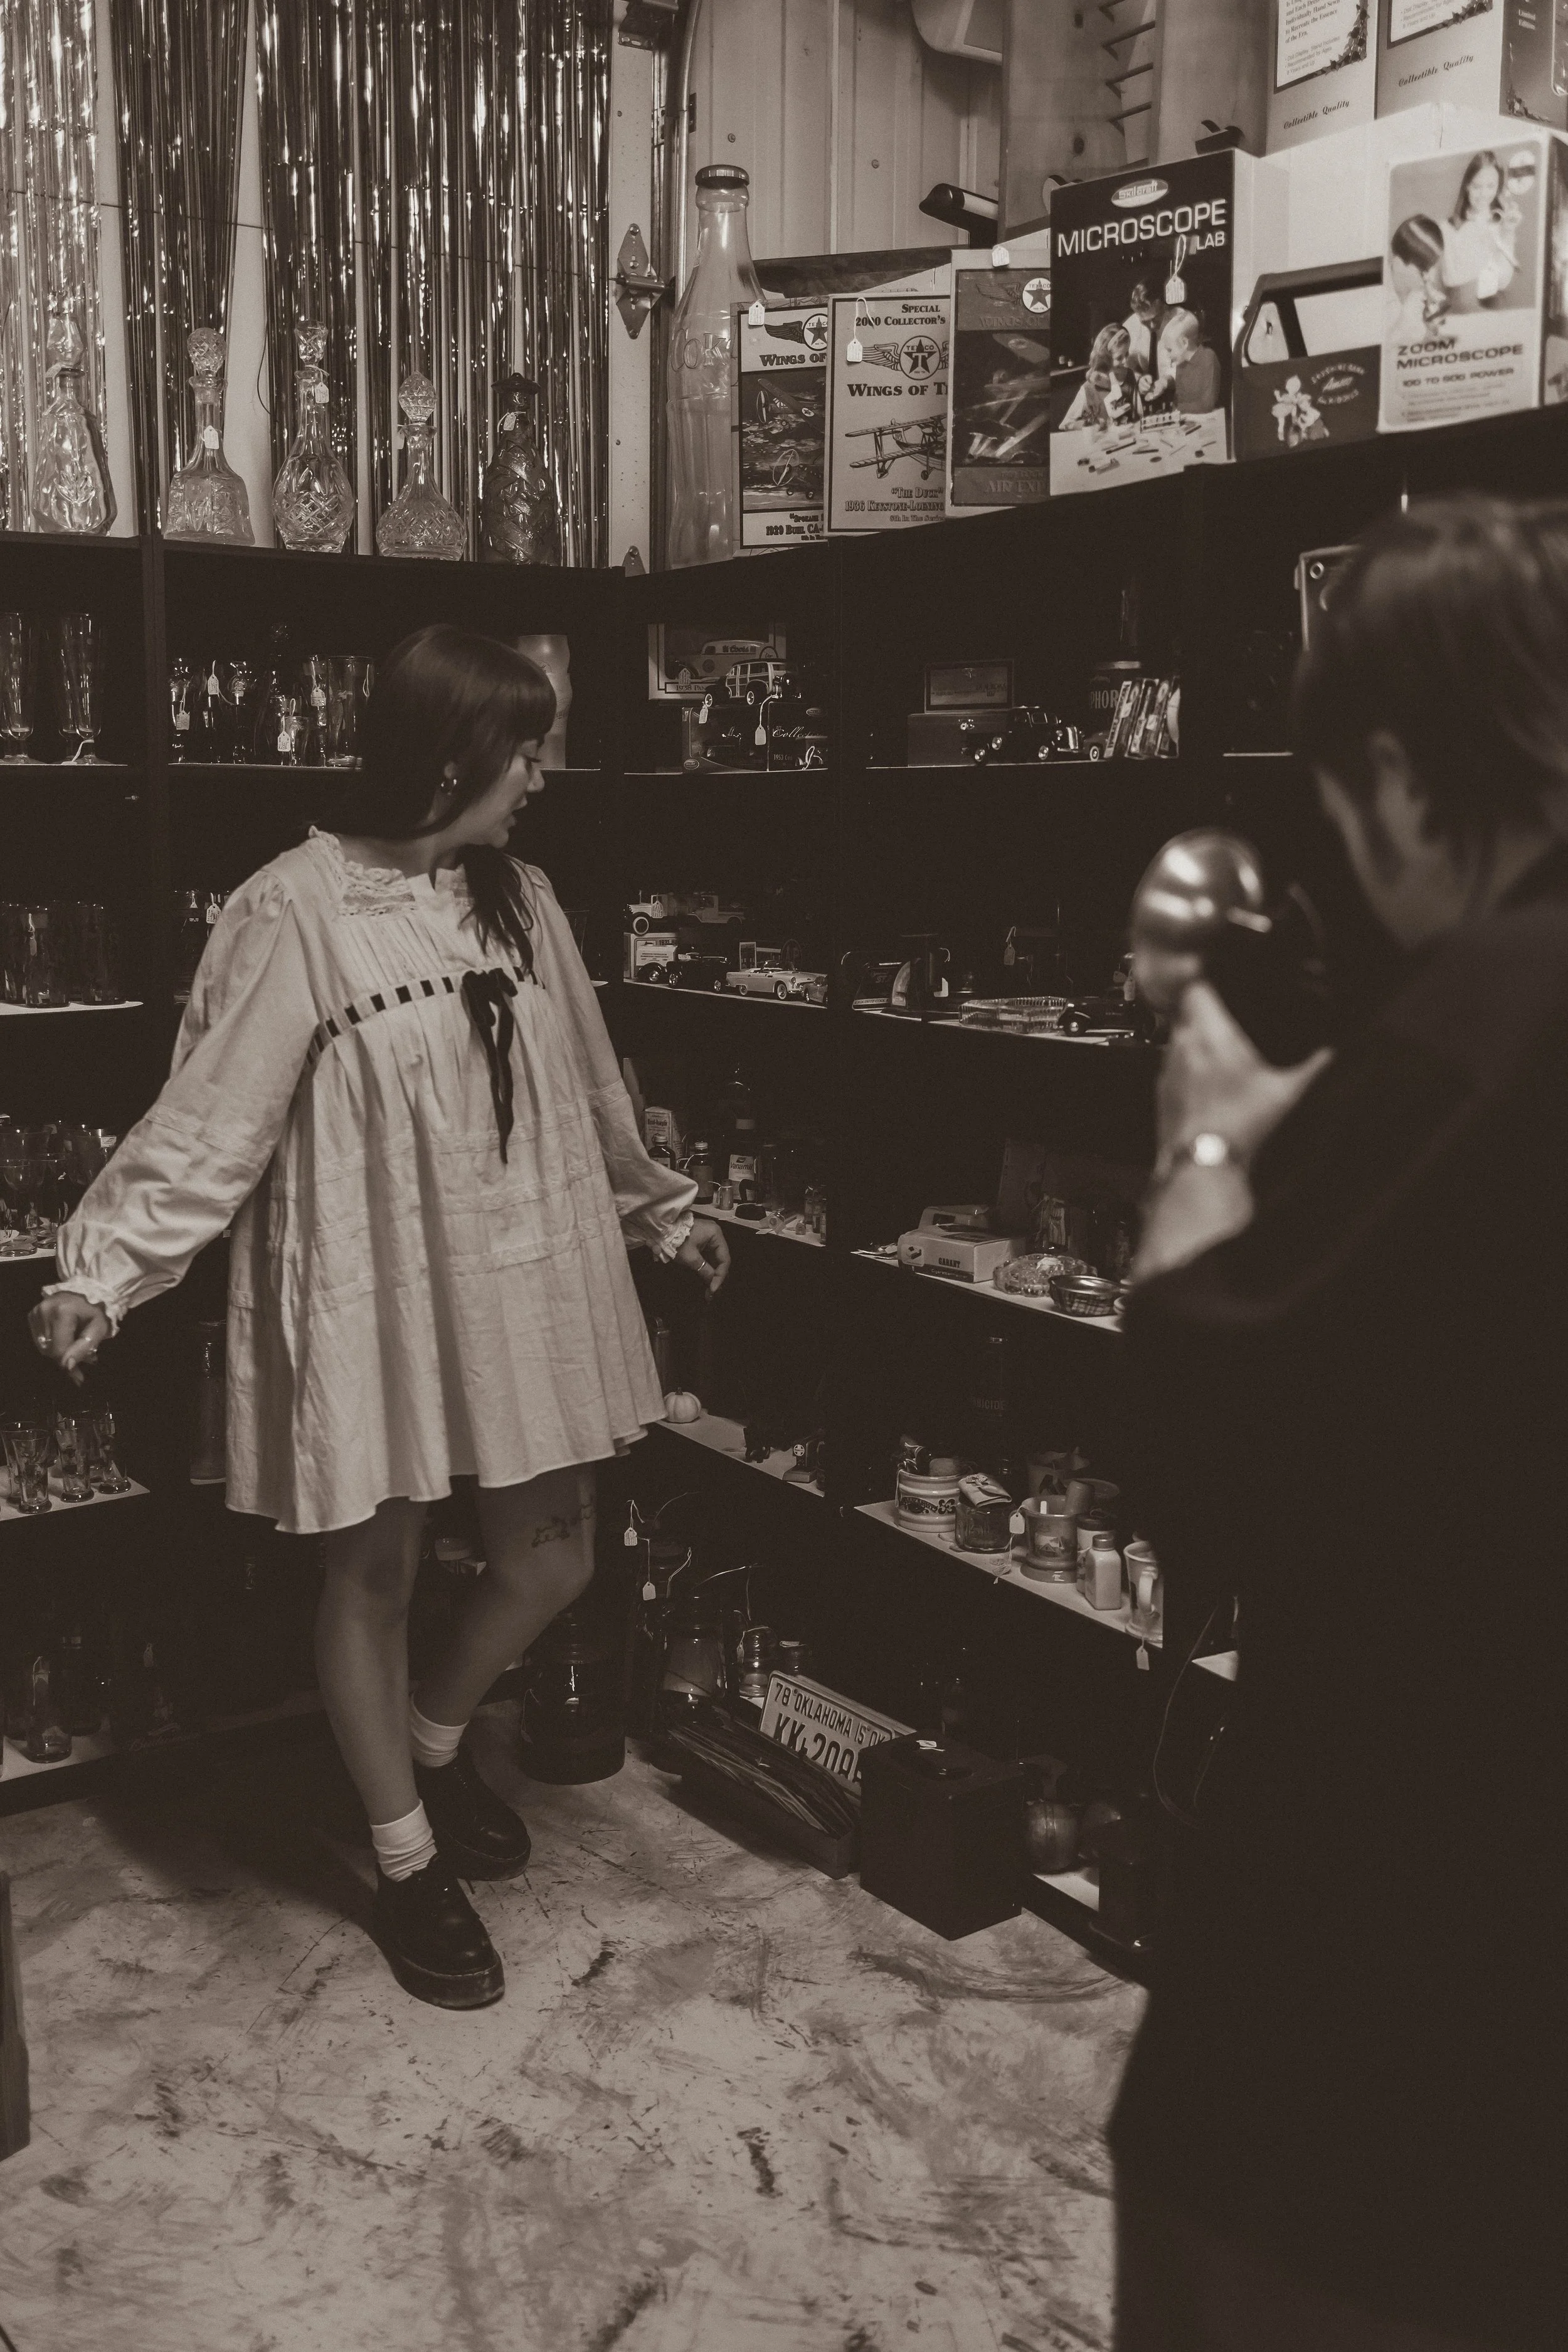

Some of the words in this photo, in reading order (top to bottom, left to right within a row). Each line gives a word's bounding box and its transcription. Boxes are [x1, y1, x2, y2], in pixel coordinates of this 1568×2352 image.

[1286, 11, 1311, 26] Individually
[1313, 4, 1326, 13] Hand
[1291, 20, 1310, 31] Recreate
[1398, 66, 1438, 87] Collectible
[1443, 55, 1474, 71] Quality
[1283, 110, 1318, 129] Collectible
[1322, 100, 1350, 115] Quality
[1057, 198, 1226, 258] MICROSCOPE
[1196, 231, 1225, 251] LAB
[856, 316, 881, 327] 2000
[1397, 336, 1456, 356] ZOOM
[1397, 344, 1523, 370] MICROSCOPE
[845, 501, 866, 512] 1936
[794, 1693, 853, 1738] OKLAHOMA
[854, 1722, 867, 1745] IS
